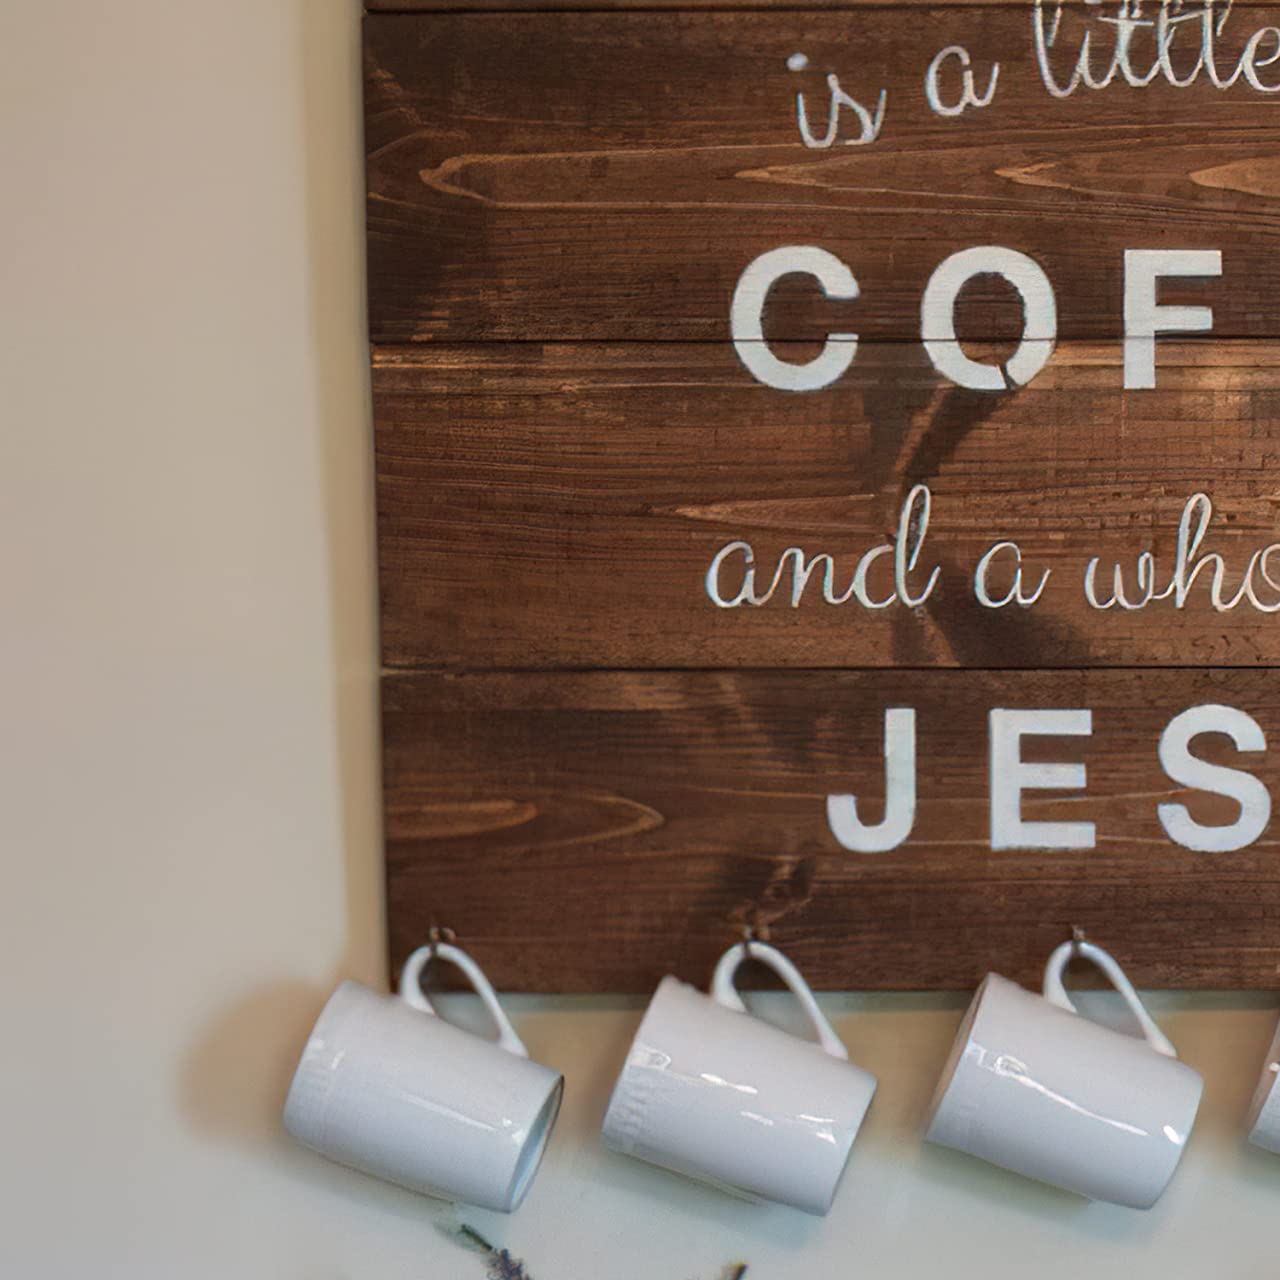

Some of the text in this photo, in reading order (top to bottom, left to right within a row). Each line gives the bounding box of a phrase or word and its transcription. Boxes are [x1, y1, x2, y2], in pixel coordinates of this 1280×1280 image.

[786, 52, 887, 149] is
[925, 45, 1000, 117] a
[705, 483, 941, 609] and
[973, 541, 1052, 608] a
